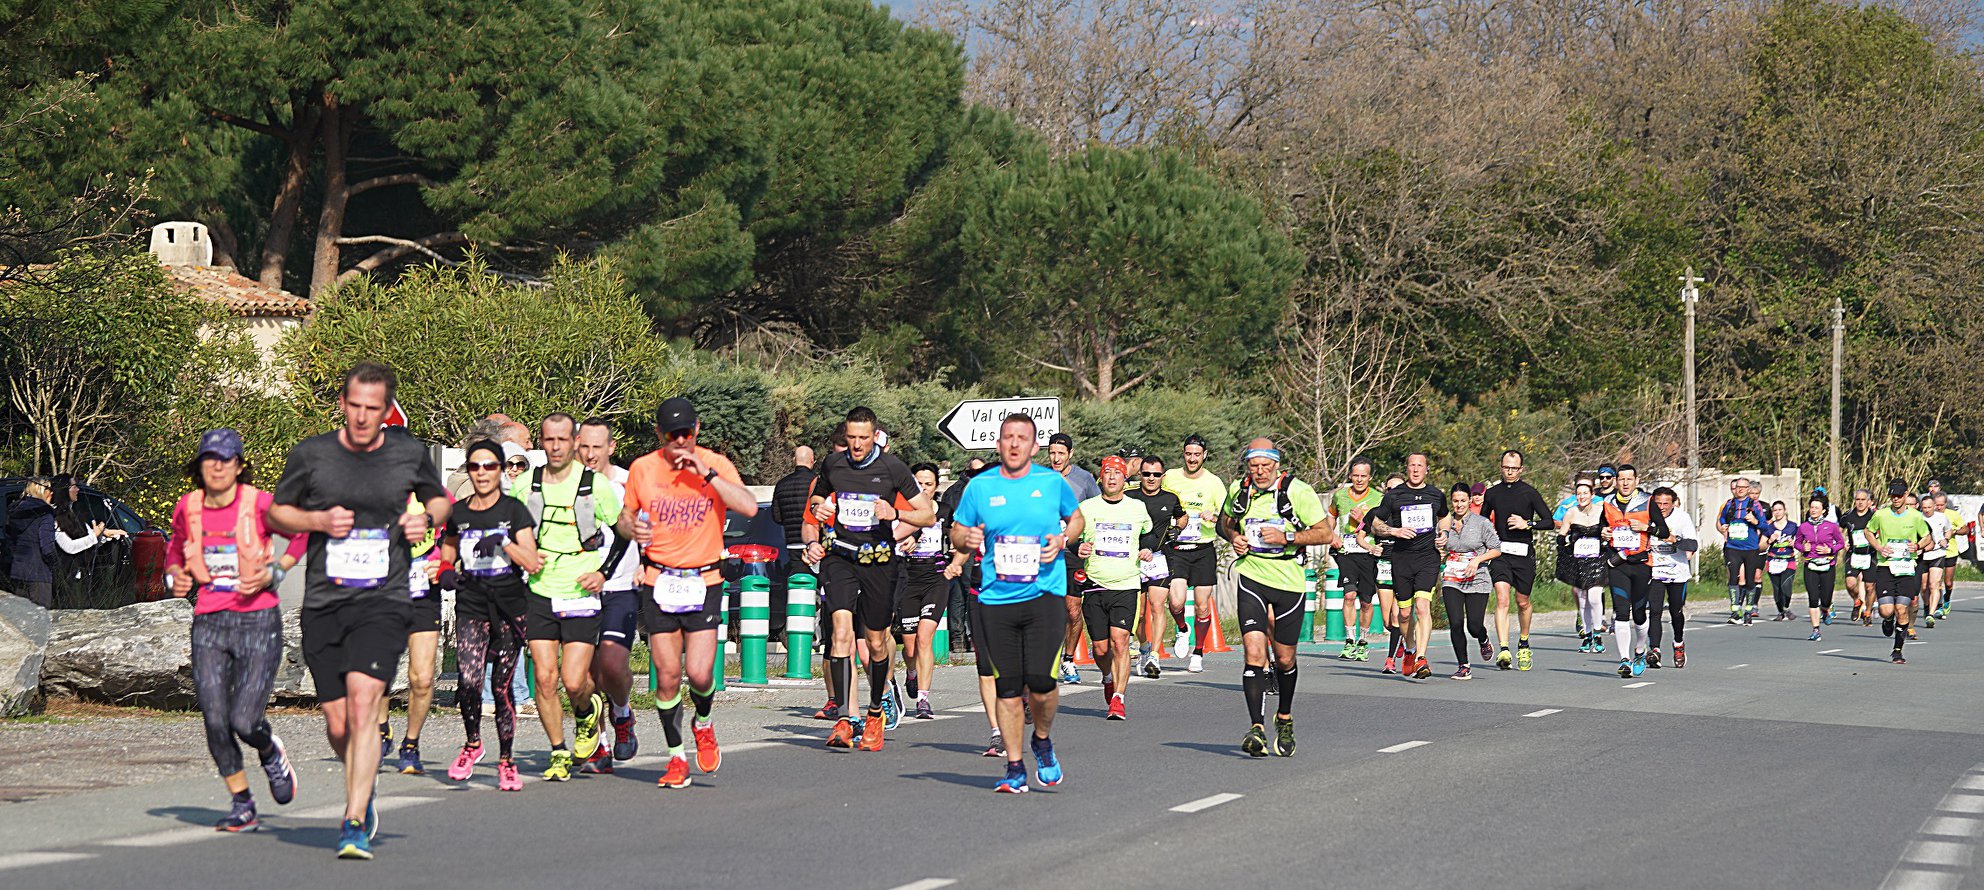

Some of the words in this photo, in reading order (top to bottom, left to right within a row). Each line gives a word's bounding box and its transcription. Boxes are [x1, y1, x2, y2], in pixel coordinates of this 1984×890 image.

[971, 409, 993, 422] Val
[971, 429, 996, 442] Les
[650, 498, 714, 514] FINISHER
[845, 508, 870, 517] 1499
[659, 511, 704, 527] PARIS
[1102, 536, 1124, 544] 1286
[344, 552, 370, 564] 742
[1002, 554, 1029, 564] 1185
[668, 583, 689, 594] 824
